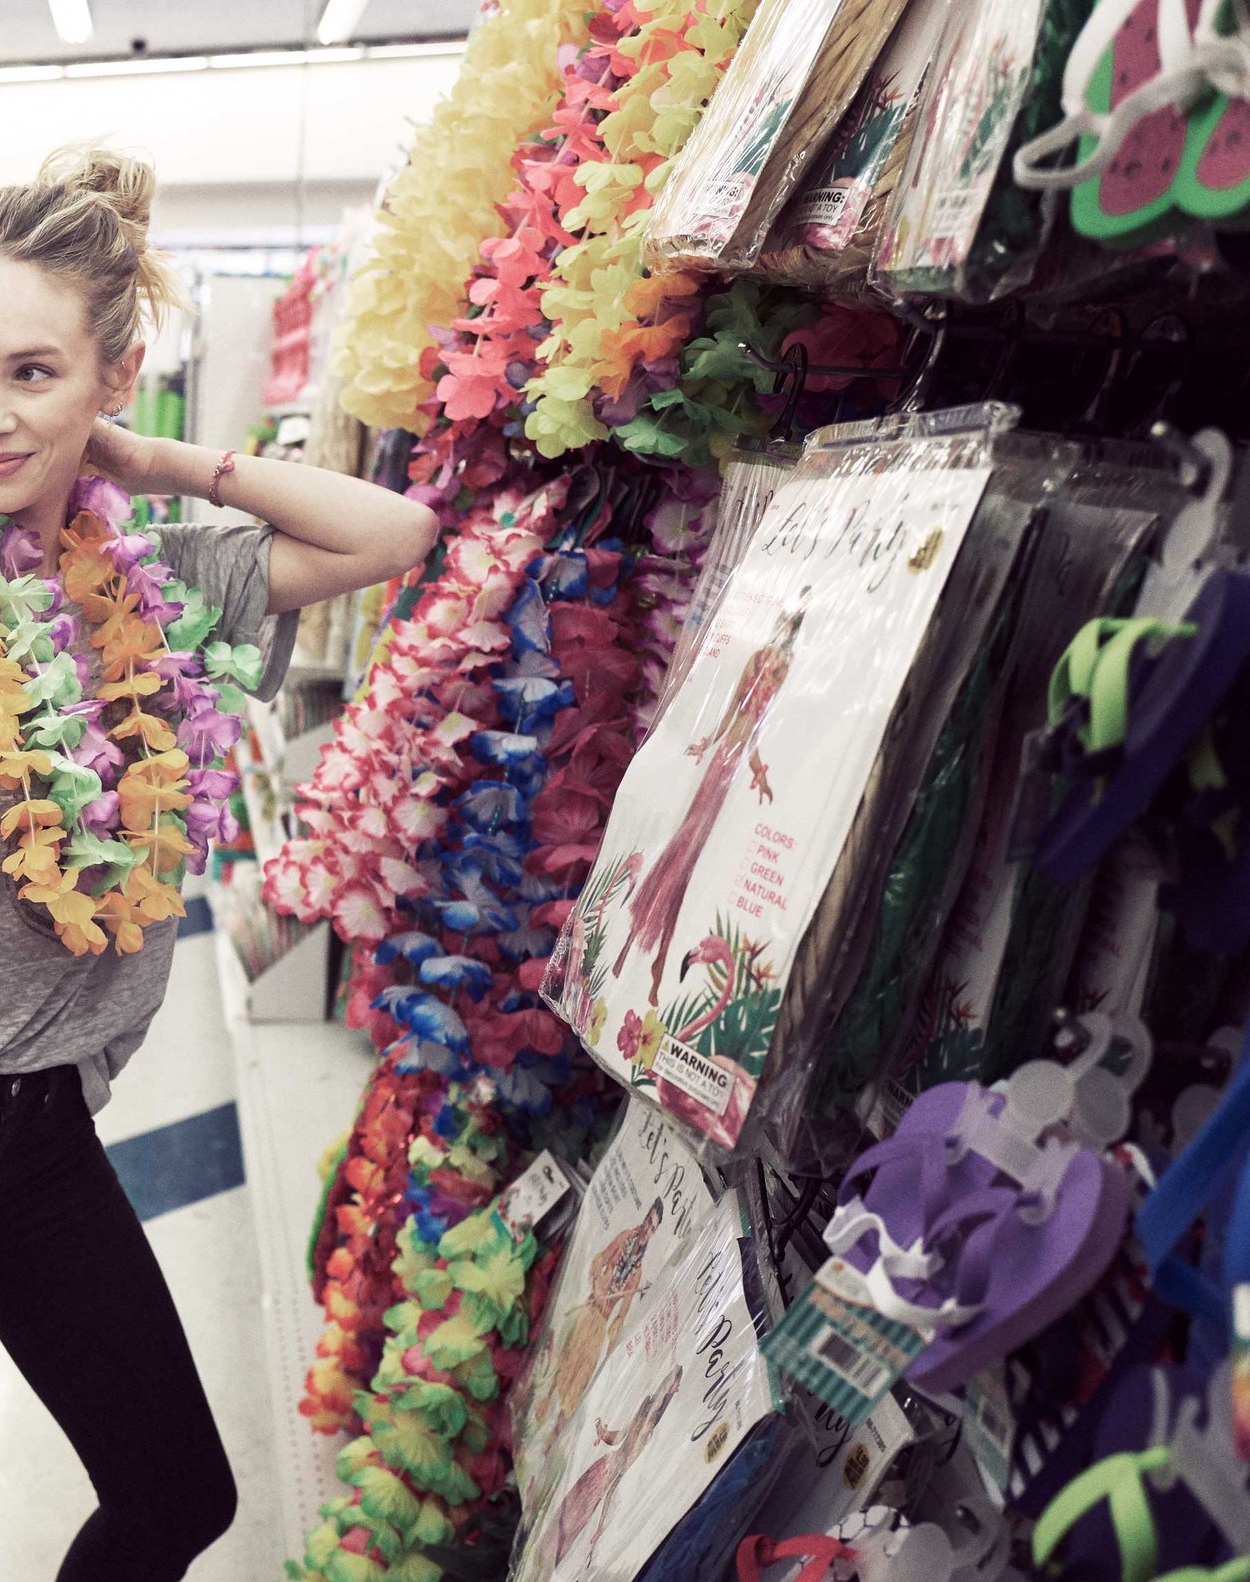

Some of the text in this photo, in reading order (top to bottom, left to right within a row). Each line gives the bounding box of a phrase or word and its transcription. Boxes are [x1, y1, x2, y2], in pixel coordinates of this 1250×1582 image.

[757, 844, 780, 863] PINK
[750, 862, 784, 887] GREEN
[743, 879, 787, 911] NATURAL
[736, 896, 764, 918] BLUE
